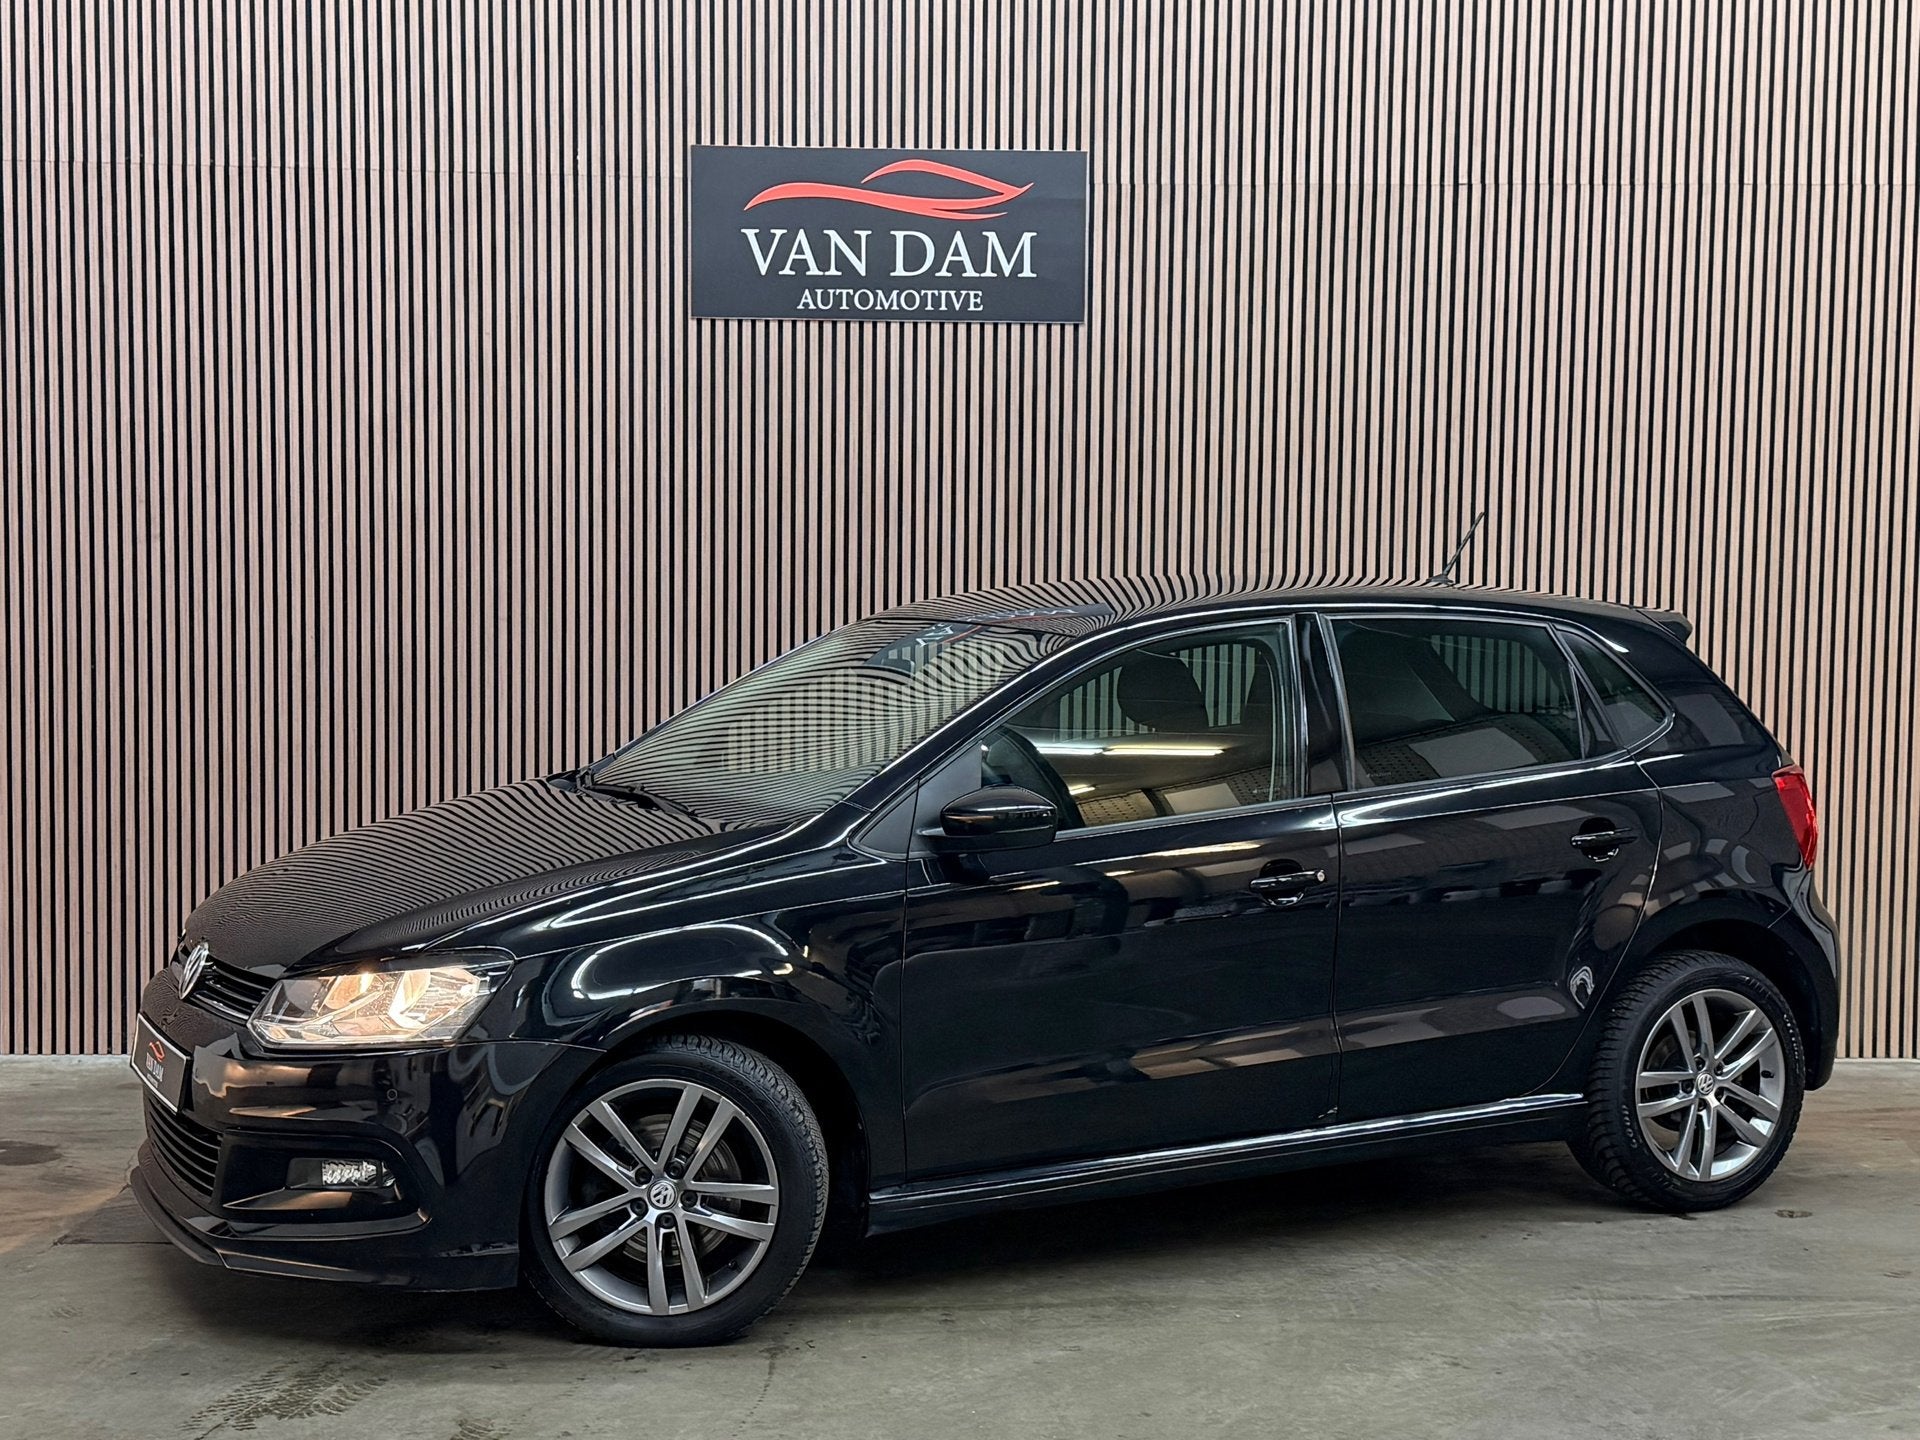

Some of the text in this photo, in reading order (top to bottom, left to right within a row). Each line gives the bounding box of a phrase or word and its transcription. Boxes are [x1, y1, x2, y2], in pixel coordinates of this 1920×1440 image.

[740, 228, 1038, 278] VAN DAM
[796, 288, 984, 311] AUTOMOTIVE
